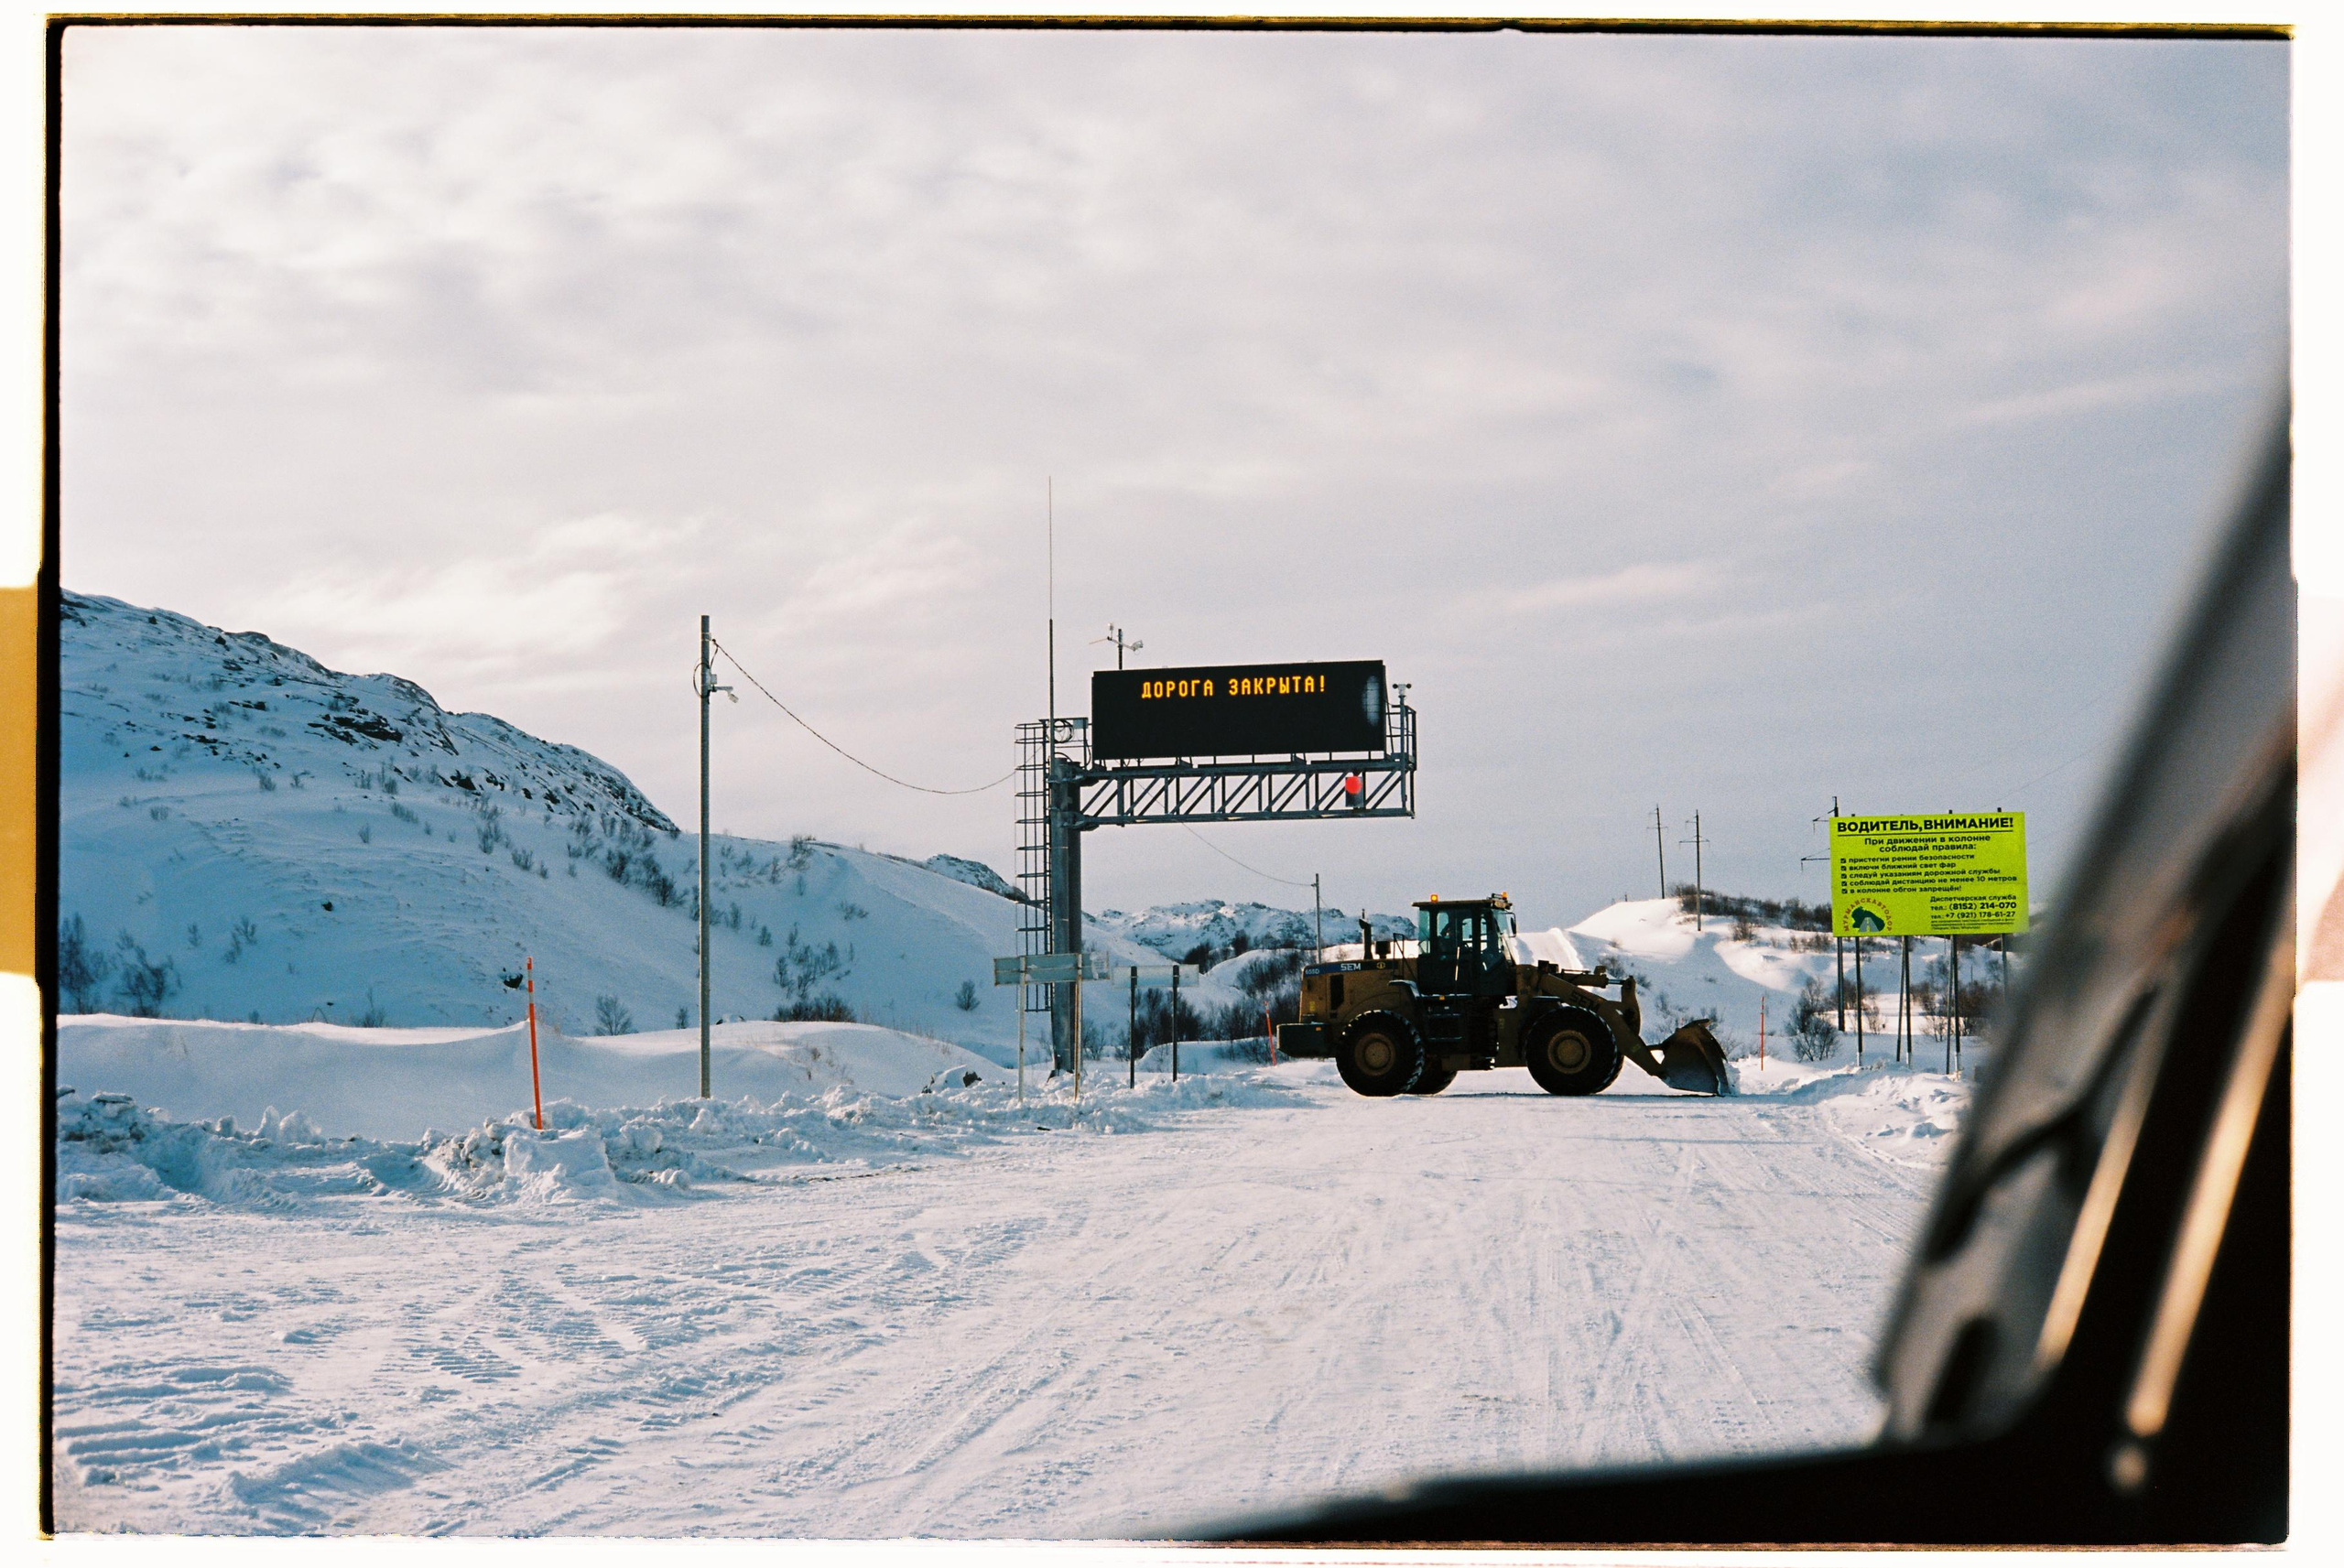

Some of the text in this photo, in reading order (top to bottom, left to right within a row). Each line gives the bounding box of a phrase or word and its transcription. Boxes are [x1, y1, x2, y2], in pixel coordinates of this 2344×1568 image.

[1142, 676, 1325, 698] ДОРОГА ЗАКРЫТА!
[1880, 844, 1929, 852] соблюдай
